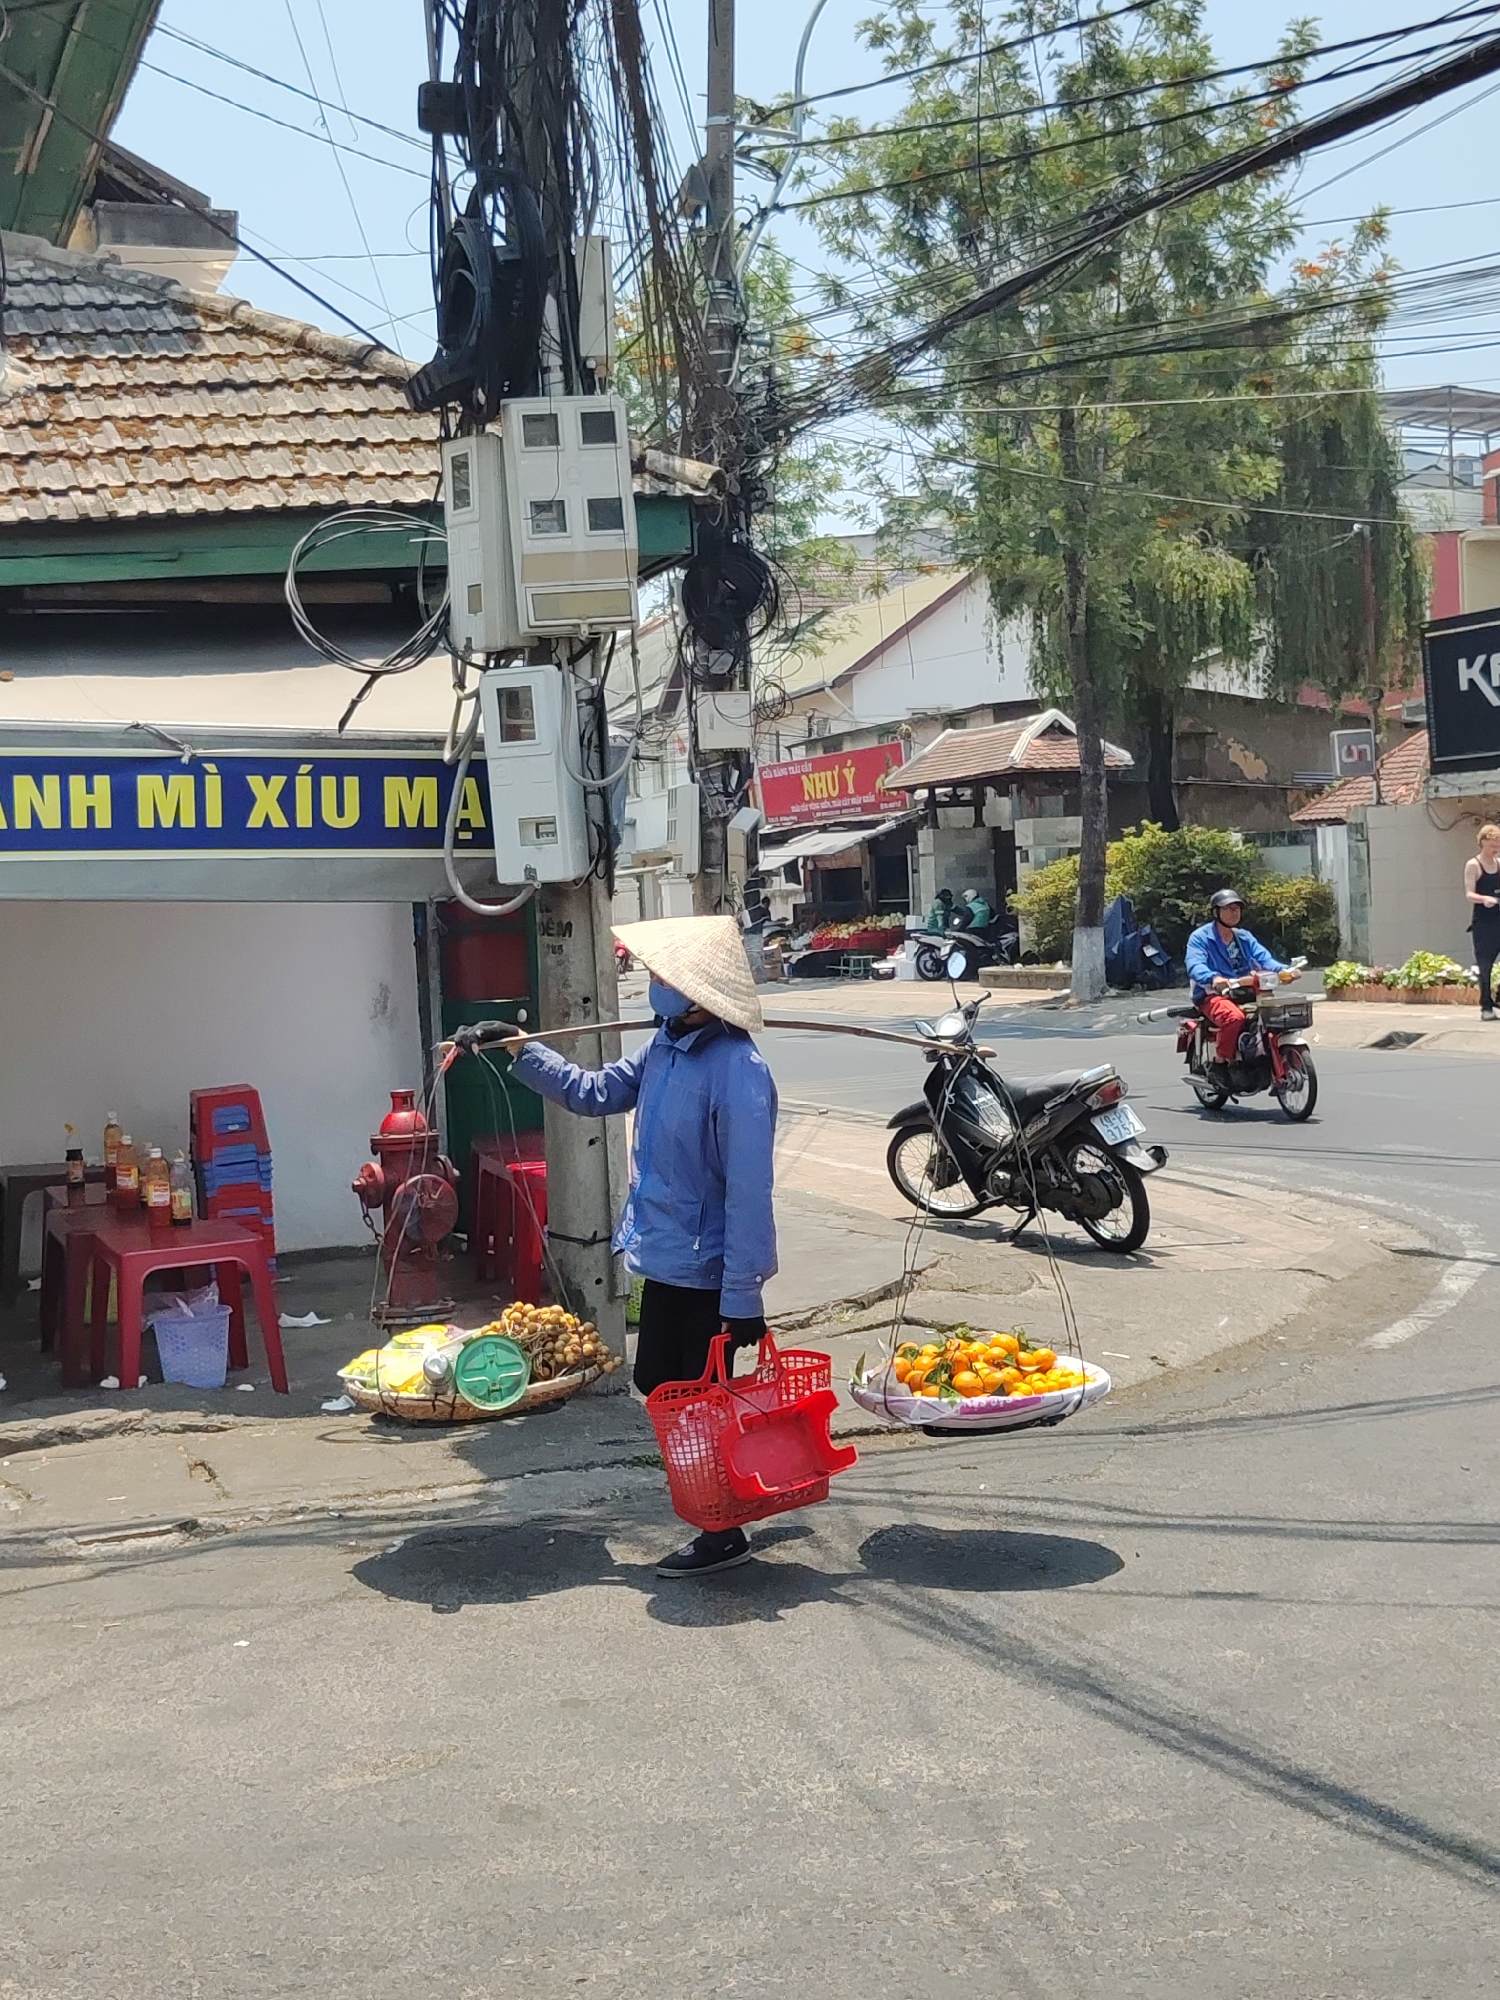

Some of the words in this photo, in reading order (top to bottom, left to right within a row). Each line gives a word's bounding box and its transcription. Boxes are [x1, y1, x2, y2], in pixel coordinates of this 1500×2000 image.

[0, 775, 112, 829] NH
[137, 763, 223, 829] MÌ
[246, 764, 360, 829] XÍU
[801, 764, 840, 801] NHƯ
[843, 759, 856, 795] Ý
[1107, 1121, 1142, 1141] 3752
